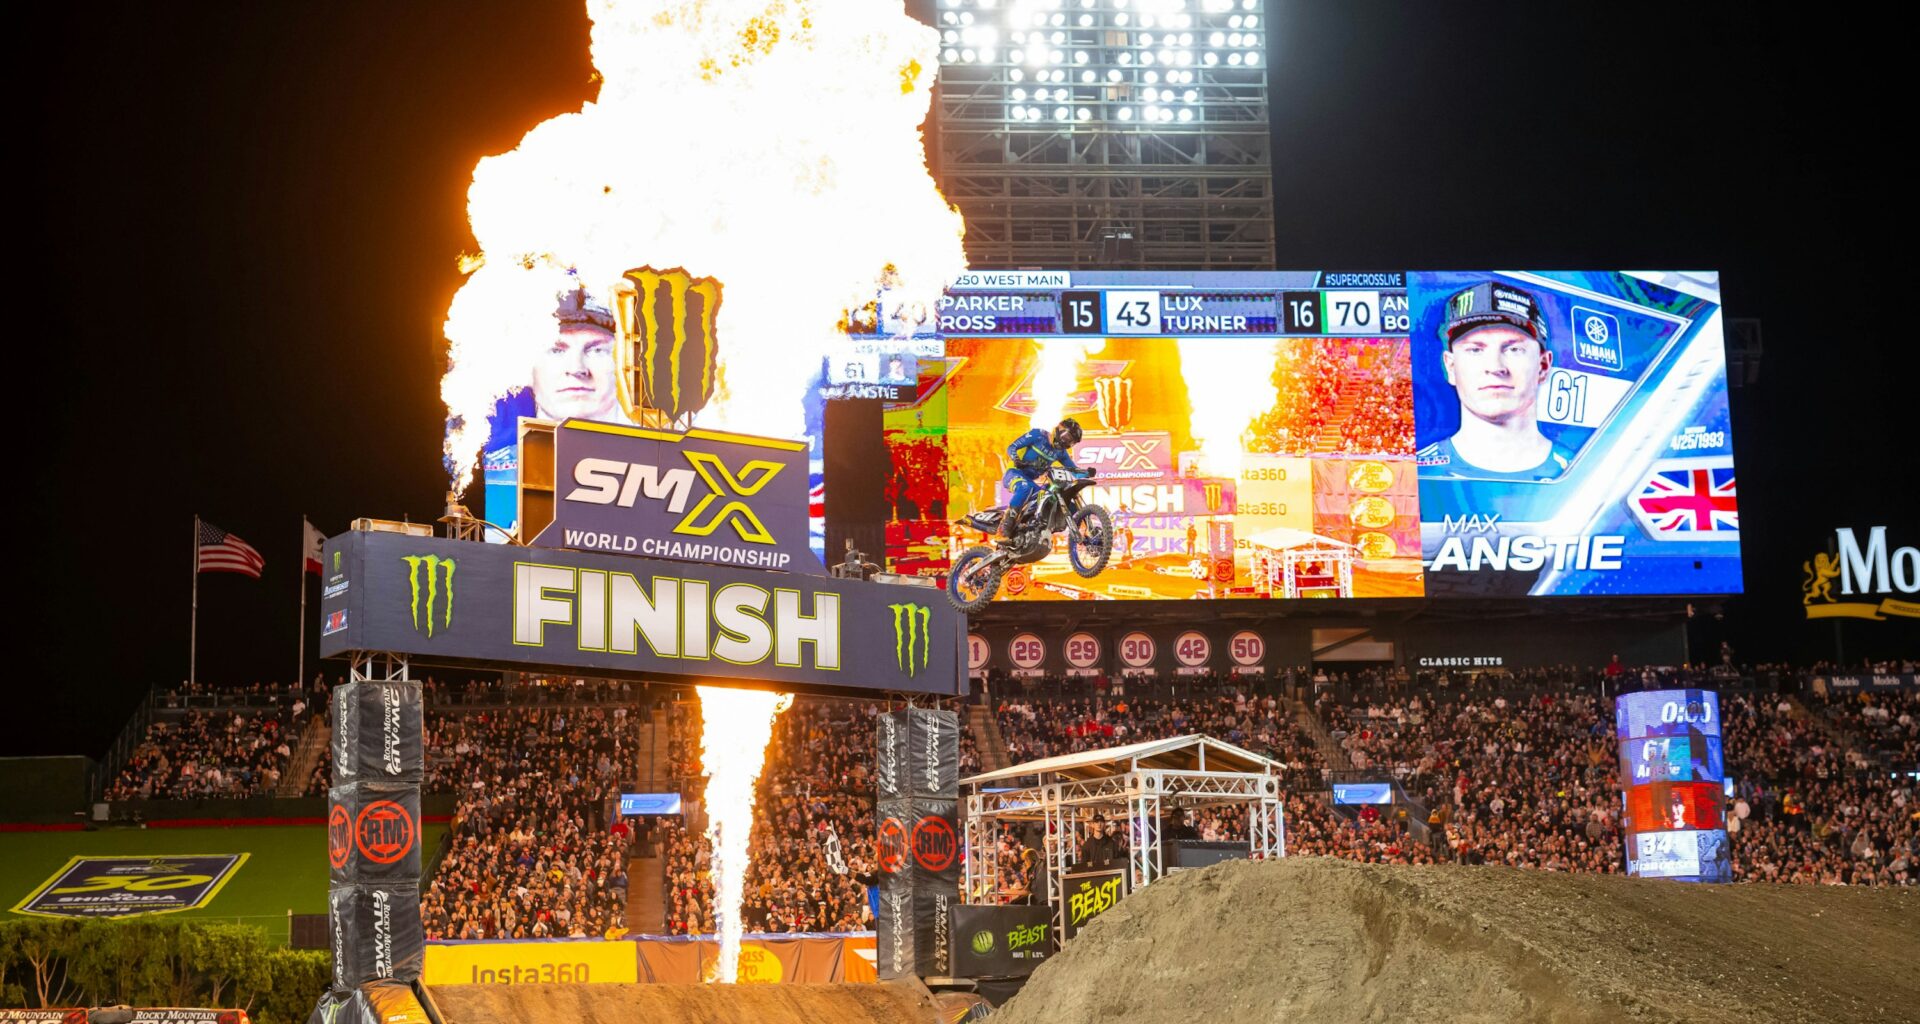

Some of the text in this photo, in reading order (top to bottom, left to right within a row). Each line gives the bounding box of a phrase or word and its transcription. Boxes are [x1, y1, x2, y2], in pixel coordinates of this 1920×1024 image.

[956, 275, 1064, 286] 250 WEST MAIN
[1325, 273, 1401, 286] #SUPERCROSSLIVE
[941, 296, 1024, 311] PARKER
[1163, 296, 1203, 311] LUX
[1383, 296, 1409, 310] AN
[941, 315, 997, 330] ROSS
[1069, 301, 1094, 327] 15
[1116, 301, 1152, 327] 43
[1163, 315, 1246, 330] TURNER
[1290, 301, 1315, 327] 16
[1335, 302, 1371, 326] 70
[1580, 342, 1617, 361] YAMAHA
[845, 362, 865, 379] 61
[1547, 371, 1589, 423] 61
[1077, 440, 1161, 470] SMX
[1105, 471, 1164, 480] CHAMPIONSHIP
[565, 450, 786, 545] SMX
[1082, 484, 1185, 514] INISH
[1442, 513, 1500, 533] MAX
[566, 529, 790, 568] WORLD CHAMPIONSHIP
[1429, 535, 1625, 572] ANSTIE
[512, 561, 842, 671] FINISH
[1015, 641, 1041, 661] 26
[1070, 640, 1096, 660] 29
[1125, 640, 1151, 659] 30
[1179, 639, 1205, 658] 42
[1234, 638, 1260, 658] 50
[1420, 656, 1502, 666] CLASSIC HITS
[1832, 677, 1859, 686] Modelo
[1873, 676, 1900, 685] Modelo
[383, 686, 391, 761] ROCKY MOUNTAIN
[1642, 739, 1671, 762] 61
[366, 819, 403, 844] RM
[921, 832, 949, 855] RM
[49, 875, 213, 894] 30
[1080, 881, 1092, 891] THE
[1068, 877, 1122, 926] BEAST
[383, 904, 394, 978] ROCKY MOUNTAIN
[1006, 924, 1048, 951] BEAST
[471, 963, 590, 984] Insta360
[8, 1010, 65, 1020] MOUNTAIN
[135, 1010, 217, 1020] ROCKY MOUNTAIN
